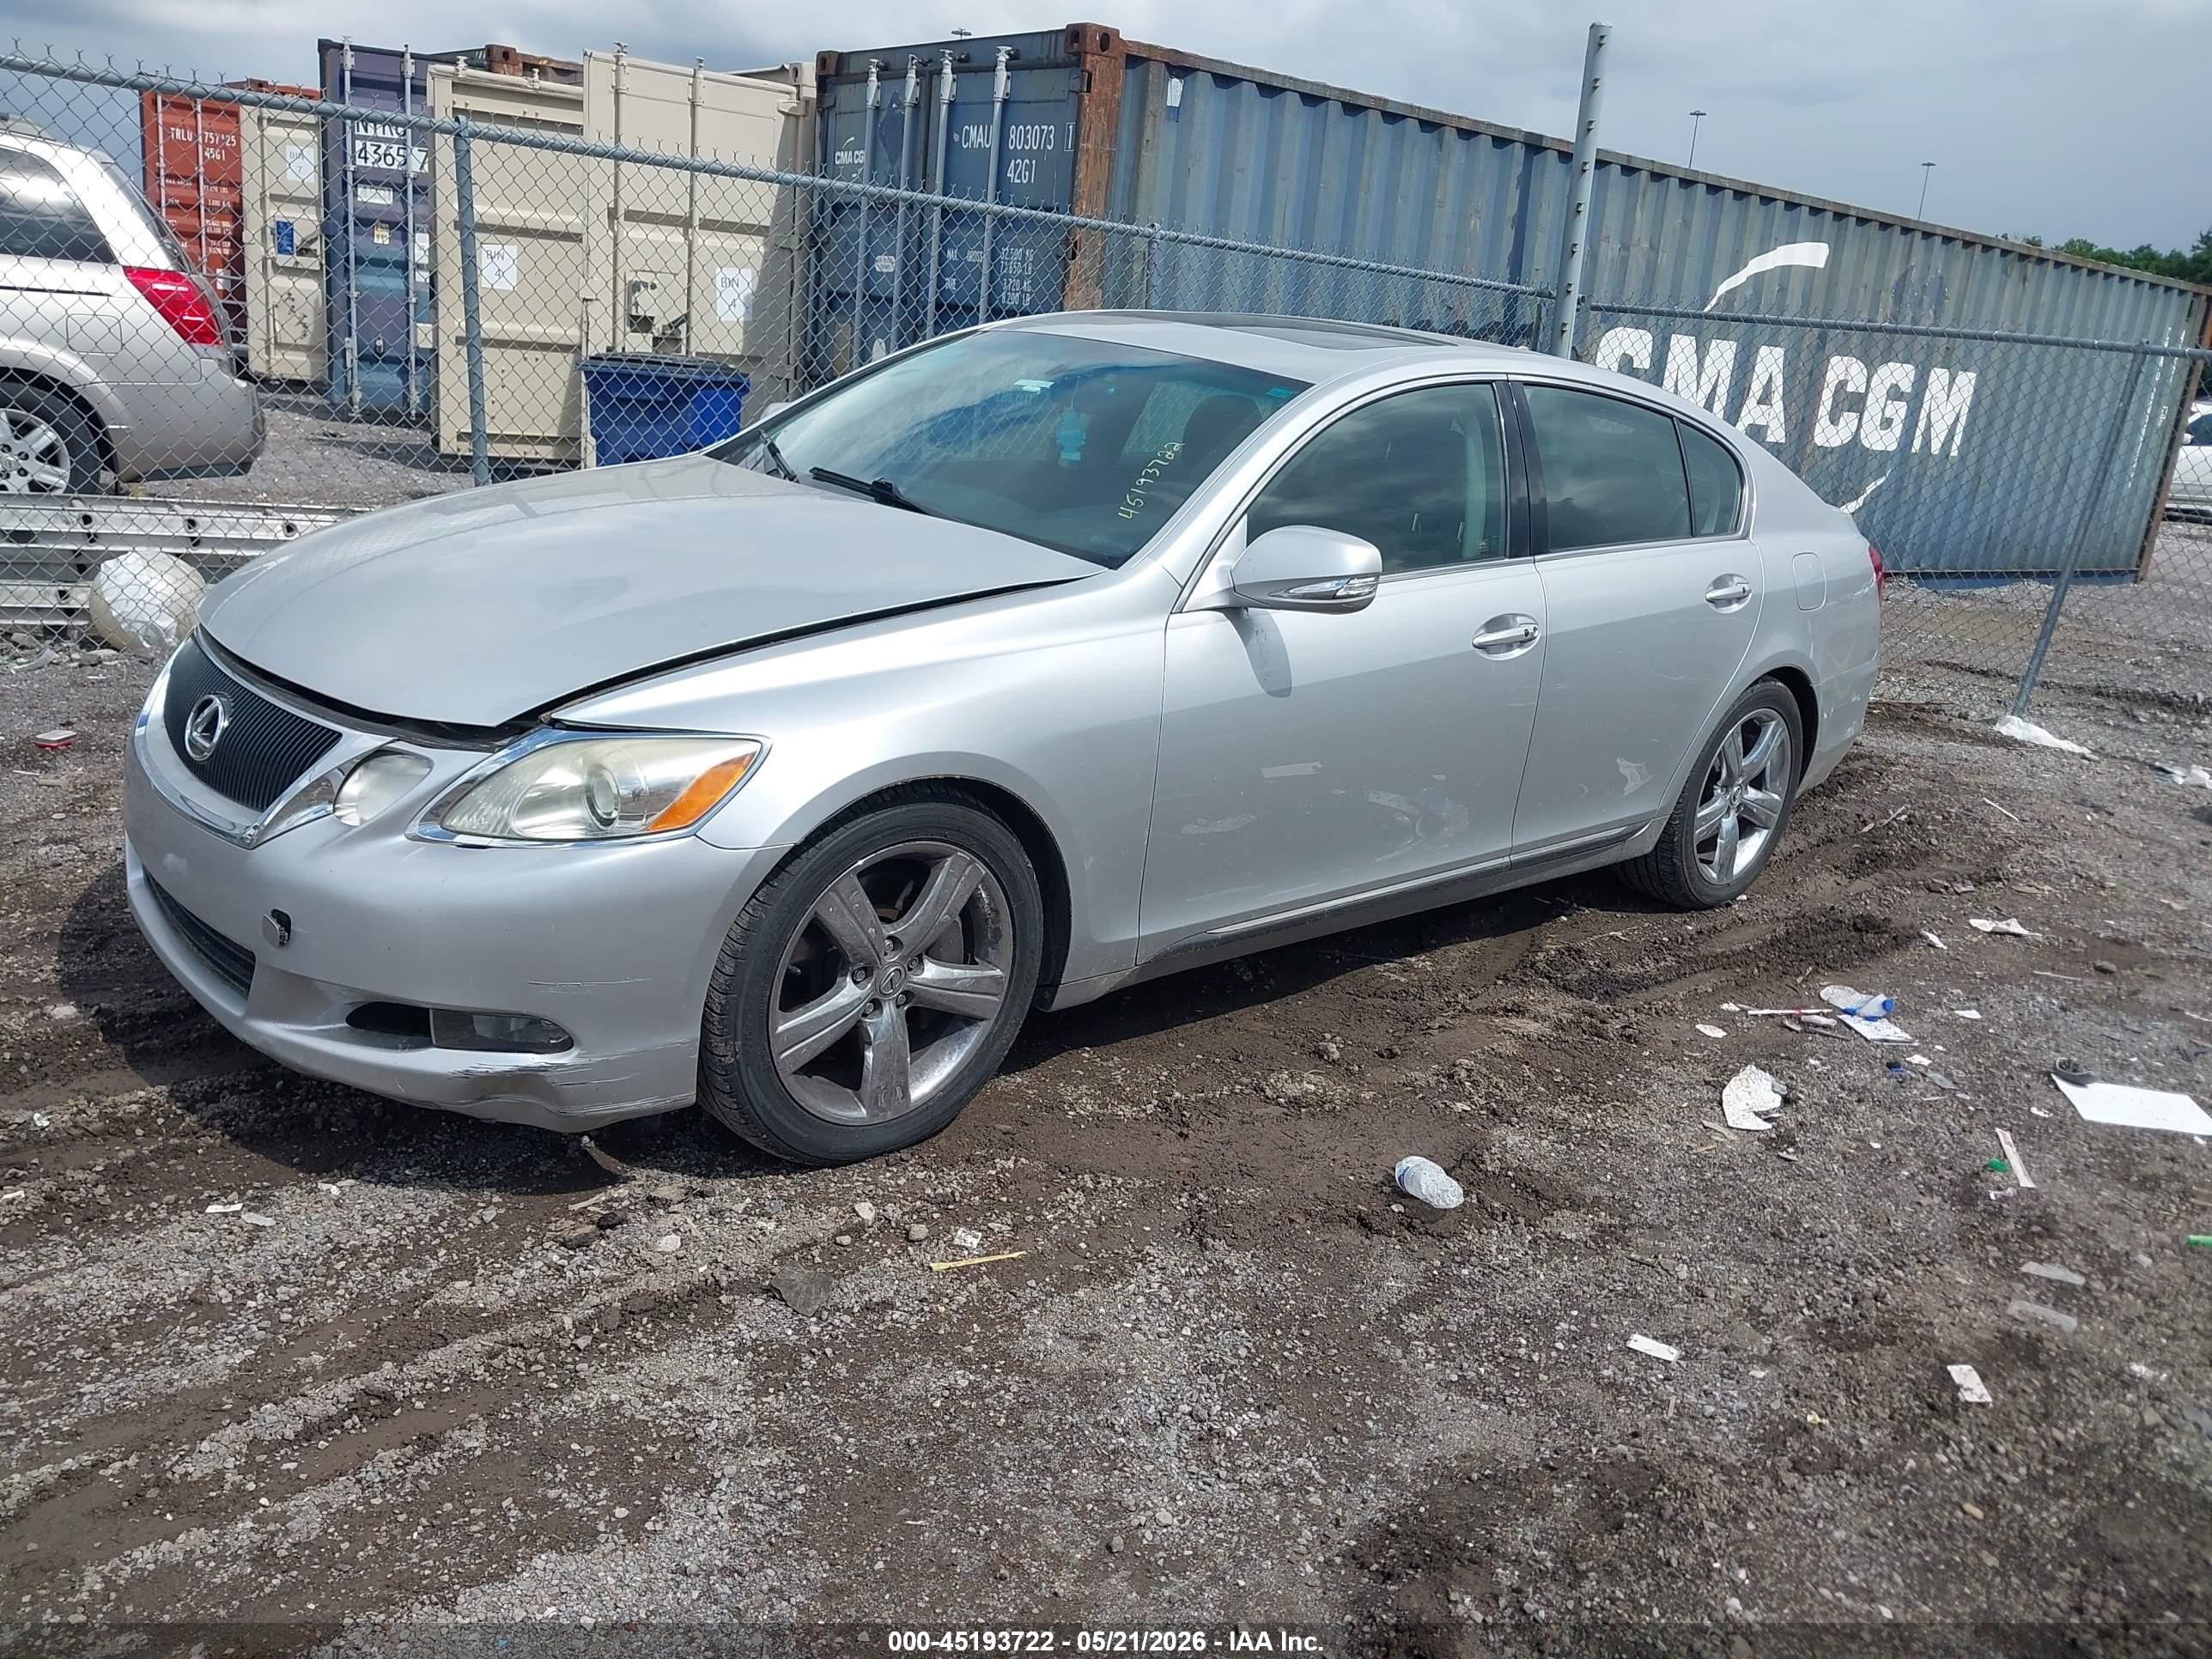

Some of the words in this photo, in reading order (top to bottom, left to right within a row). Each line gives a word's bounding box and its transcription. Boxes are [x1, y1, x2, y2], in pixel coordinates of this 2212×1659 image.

[170, 126, 193, 142] TRLU
[961, 124, 993, 149] CMAU
[1008, 125, 1055, 150] 803073
[835, 149, 853, 165] CMA
[1006, 159, 1036, 184] 42G1
[486, 249, 505, 261] BIN
[720, 276, 739, 289] BIN
[1595, 326, 1787, 443] CMA
[1813, 355, 1977, 457] CGM
[1117, 441, 1186, 520] 45193722
